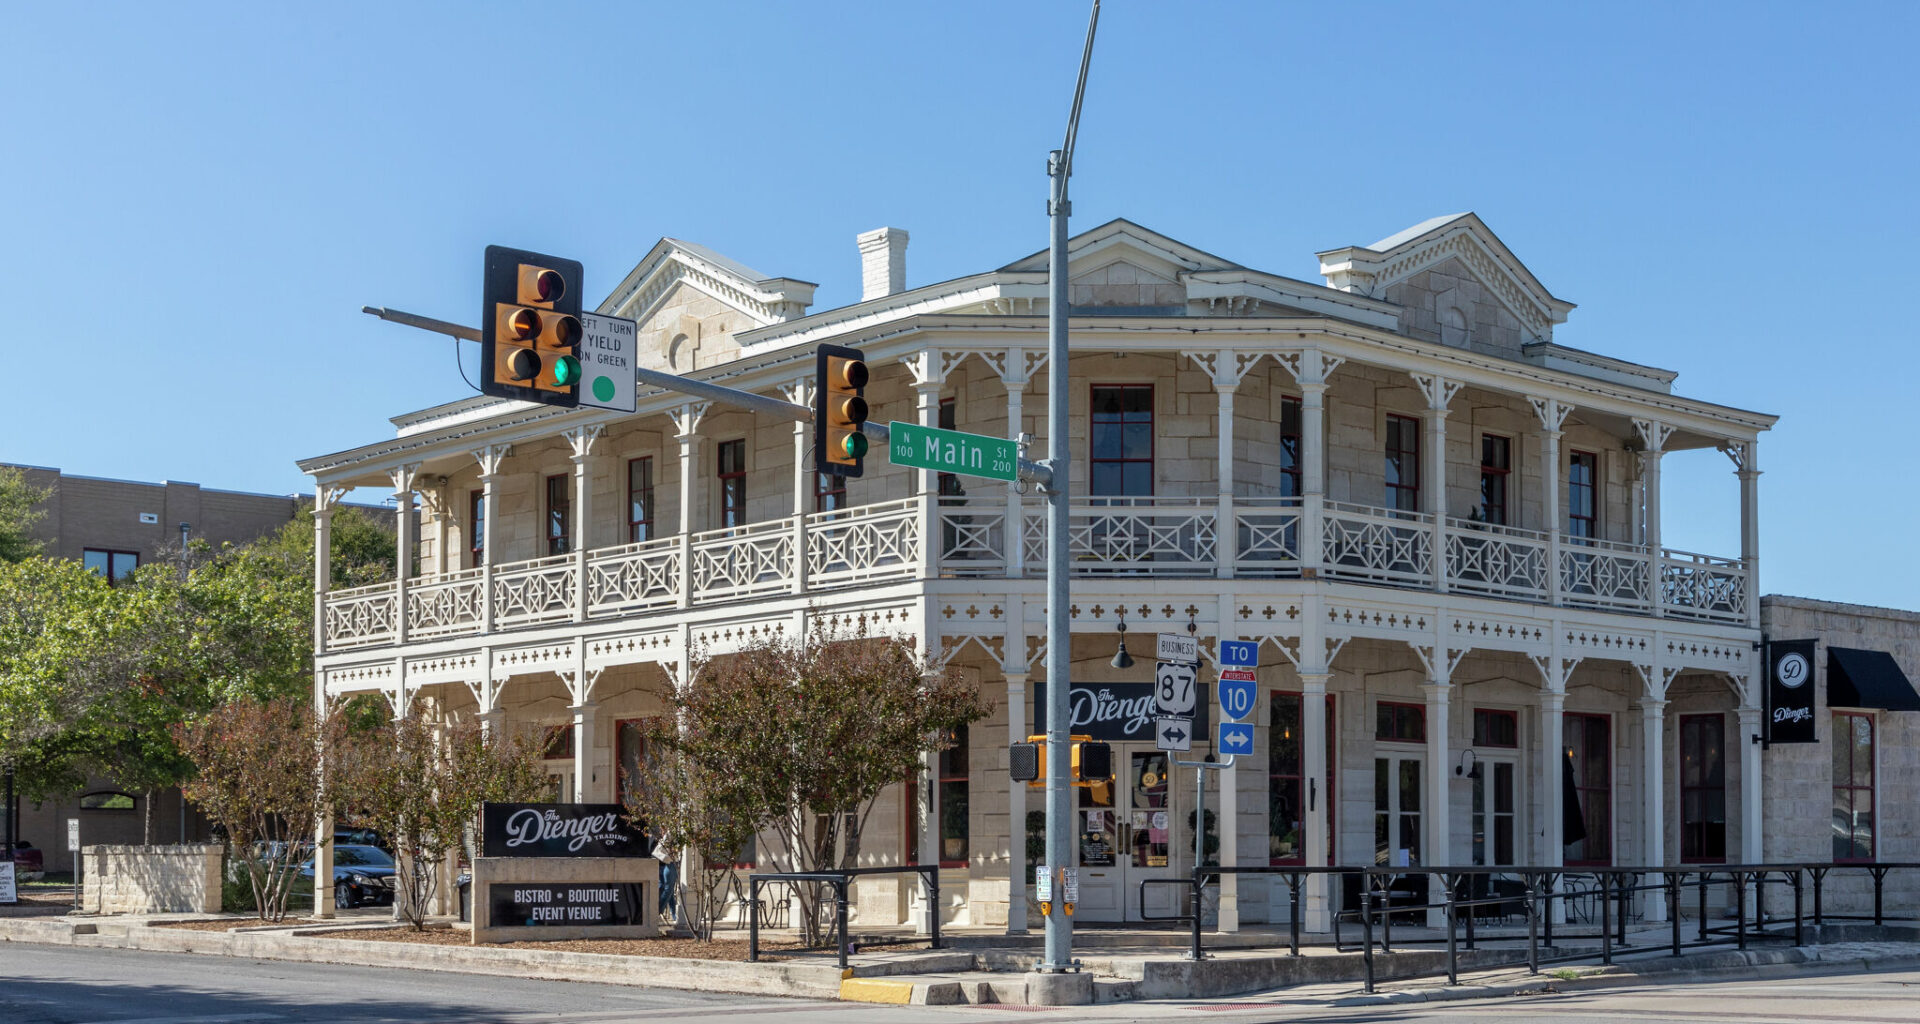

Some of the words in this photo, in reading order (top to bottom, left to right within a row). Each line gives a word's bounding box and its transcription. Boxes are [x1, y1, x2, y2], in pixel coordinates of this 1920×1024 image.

[582, 318, 597, 329] EFT
[609, 322, 632, 336] TURN
[588, 334, 621, 351] YIELD
[597, 353, 627, 368] GREEN
[896, 444, 913, 458] 100
[903, 432, 910, 443] N
[926, 436, 982, 468] Main
[997, 447, 1007, 459] St
[992, 460, 1011, 473] 200
[1161, 640, 1195, 655] BUSINESS
[1229, 645, 1248, 662] TO
[1224, 672, 1252, 681] INTERSTATE
[1784, 660, 1801, 679] D
[1098, 688, 1115, 701] The
[1161, 674, 1192, 703] 87
[1228, 687, 1248, 712] 10
[544, 809, 560, 822] The
[506, 808, 617, 852] Dienger
[594, 833, 628, 842] TRADING
[514, 889, 552, 903] BISTRO
[568, 889, 619, 903] BOUTIQUE
[532, 907, 565, 920] EVENT
[568, 906, 601, 920] VENUE
